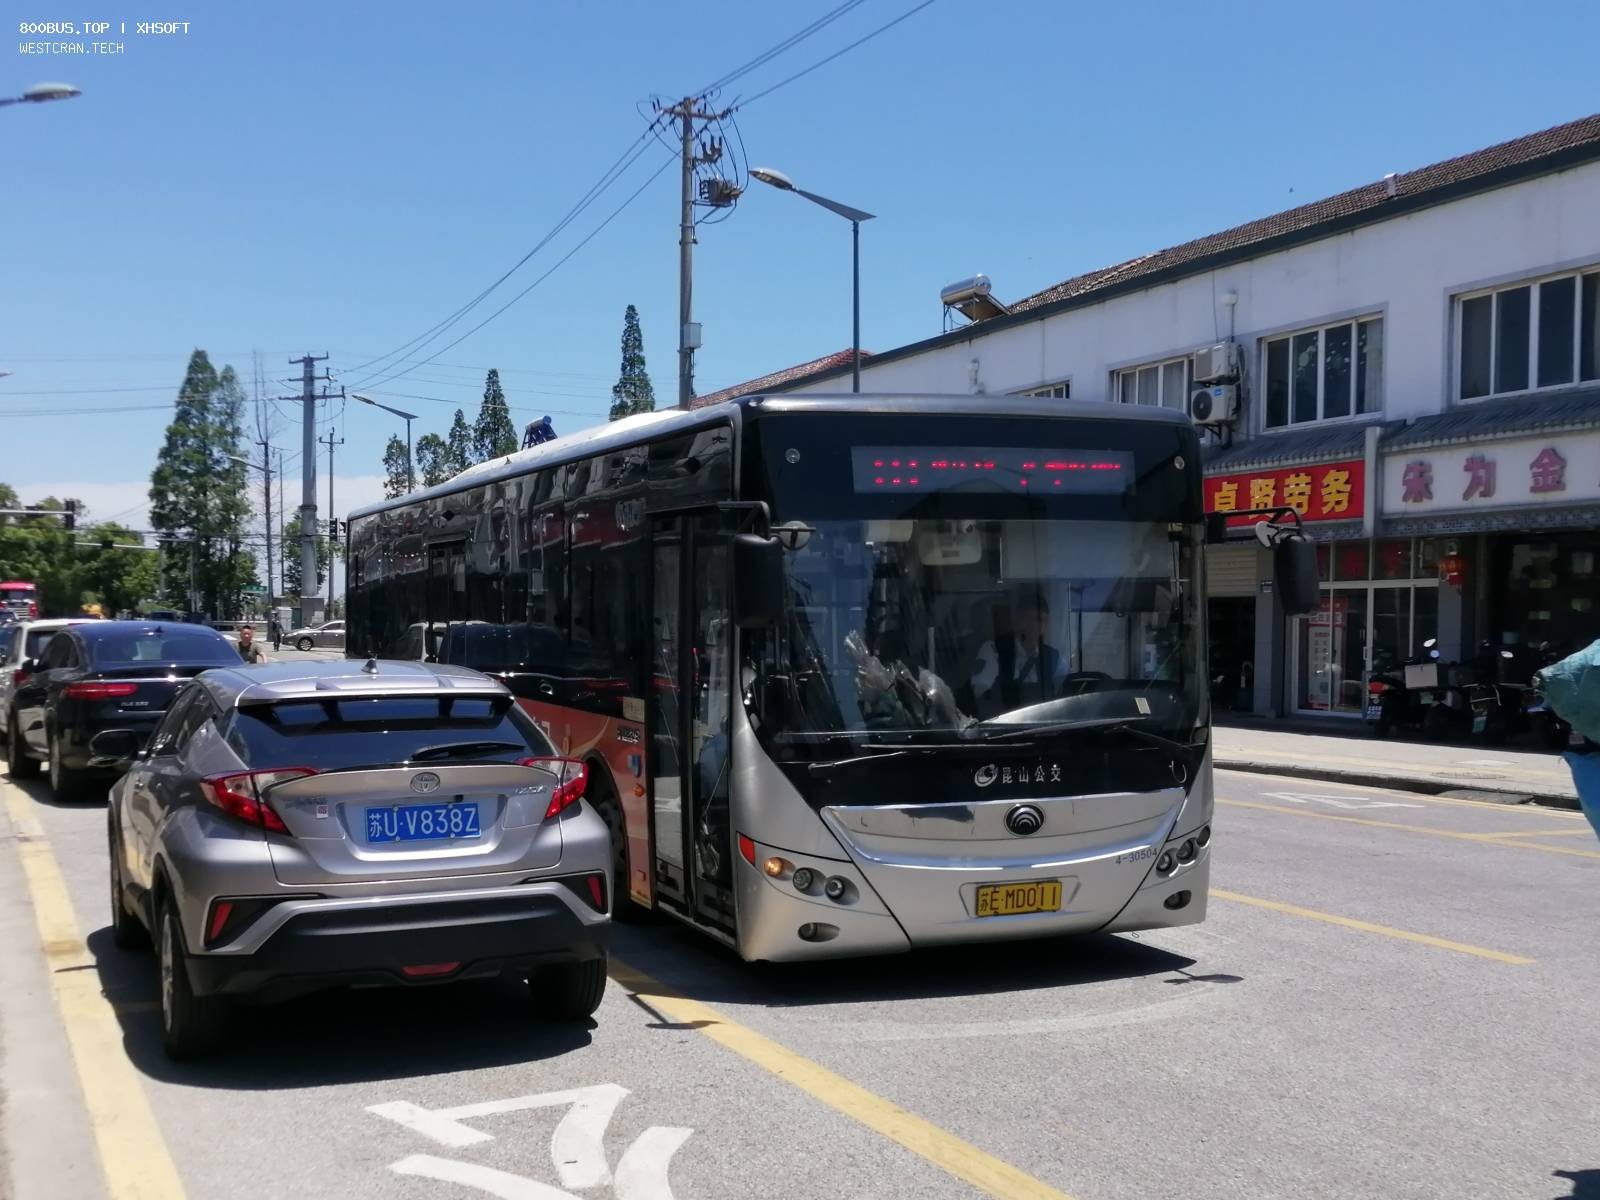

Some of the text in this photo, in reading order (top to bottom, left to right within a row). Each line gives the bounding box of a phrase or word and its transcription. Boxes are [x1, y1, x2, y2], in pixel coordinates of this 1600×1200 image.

[1002, 764, 1062, 784] 昆山公交
[1115, 848, 1158, 864] 4-30504
